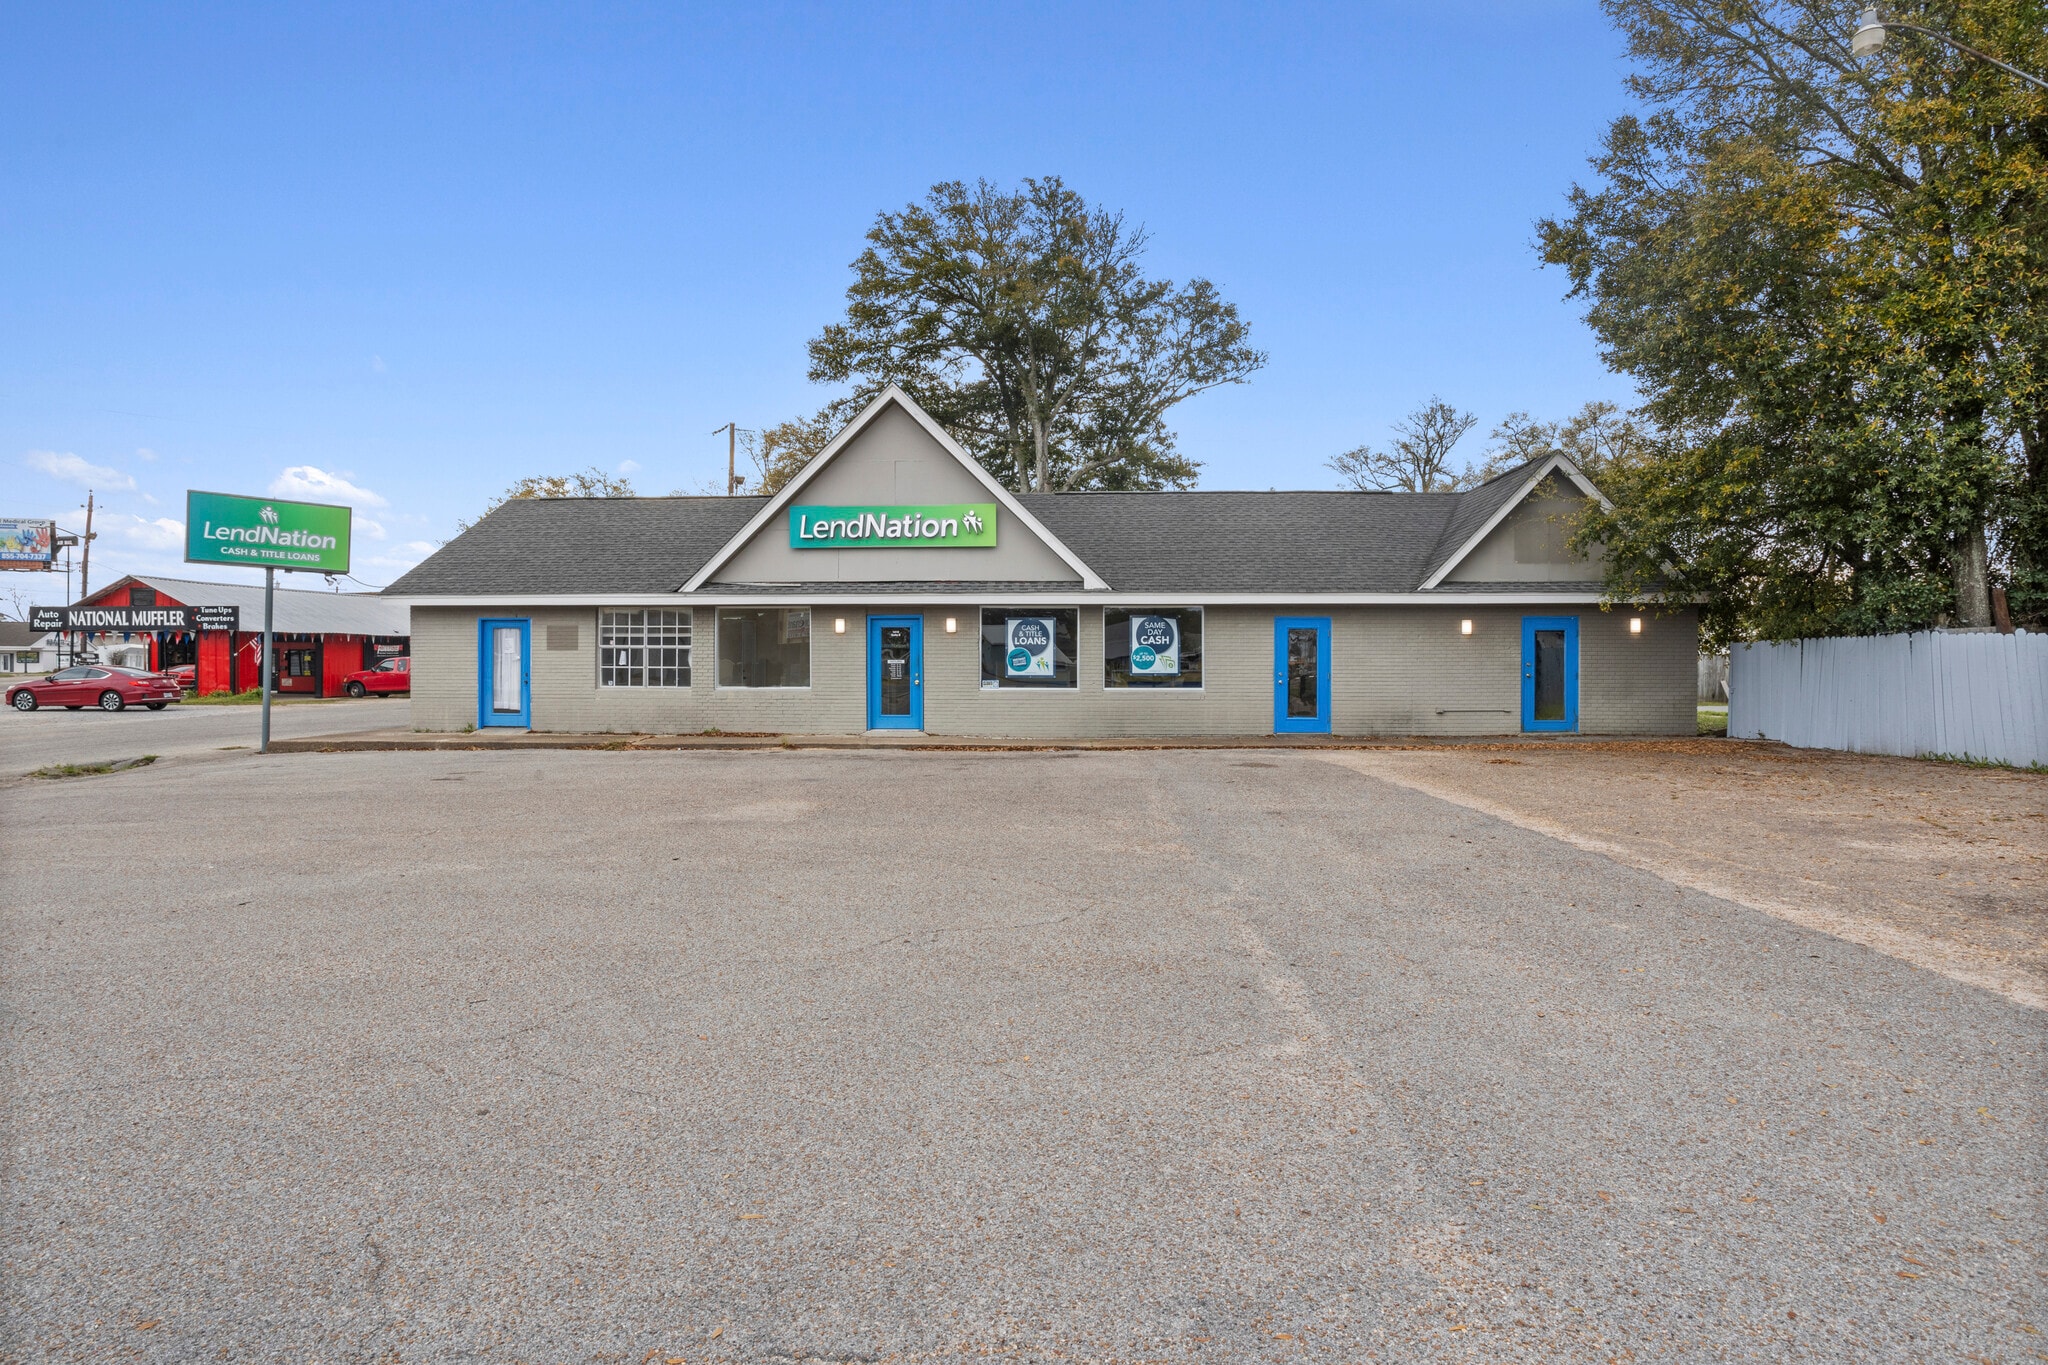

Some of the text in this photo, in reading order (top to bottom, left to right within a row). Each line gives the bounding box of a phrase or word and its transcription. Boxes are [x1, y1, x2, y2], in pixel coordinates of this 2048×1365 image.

[801, 514, 958, 539] LendNation
[204, 522, 336, 549] LendNation
[220, 546, 320, 562] CASH & TITLE LOANS
[38, 610, 59, 618] Auto
[68, 610, 185, 626] NATIONAL MUFFLER
[195, 614, 235, 622] Converters
[34, 619, 62, 630] Repair
[202, 622, 228, 630] Brakes
[1144, 621, 1166, 629] SAME
[1147, 628, 1163, 636] DAY
[1014, 636, 1047, 645] LOANS
[1140, 635, 1170, 645] CASH
